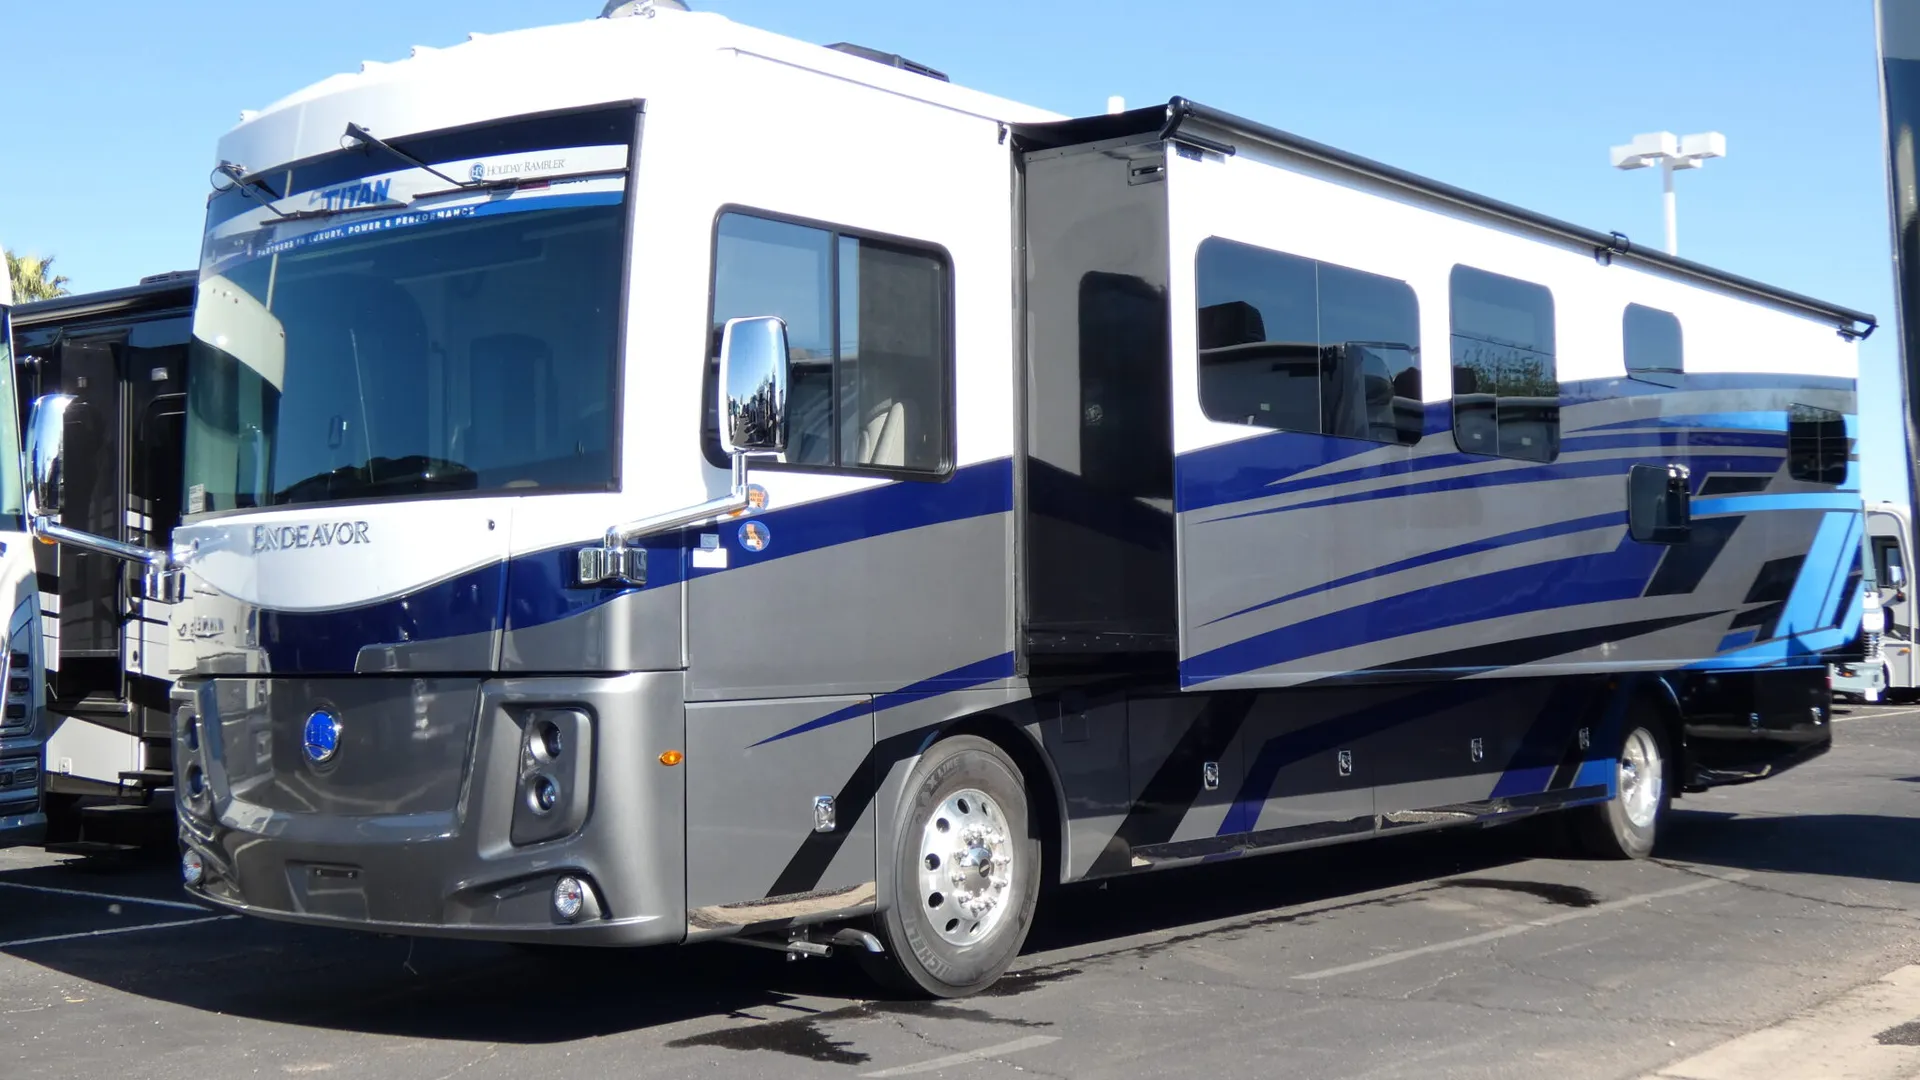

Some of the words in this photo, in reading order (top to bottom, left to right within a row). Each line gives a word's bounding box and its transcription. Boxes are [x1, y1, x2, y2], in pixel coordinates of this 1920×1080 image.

[486, 163, 522, 176] HOLIDAY
[524, 159, 565, 172] RAMBLER
[319, 178, 392, 212] TITAN
[257, 240, 294, 257] PARTNERS
[348, 221, 381, 234] POWER
[253, 521, 371, 554] ENDEAVOR
